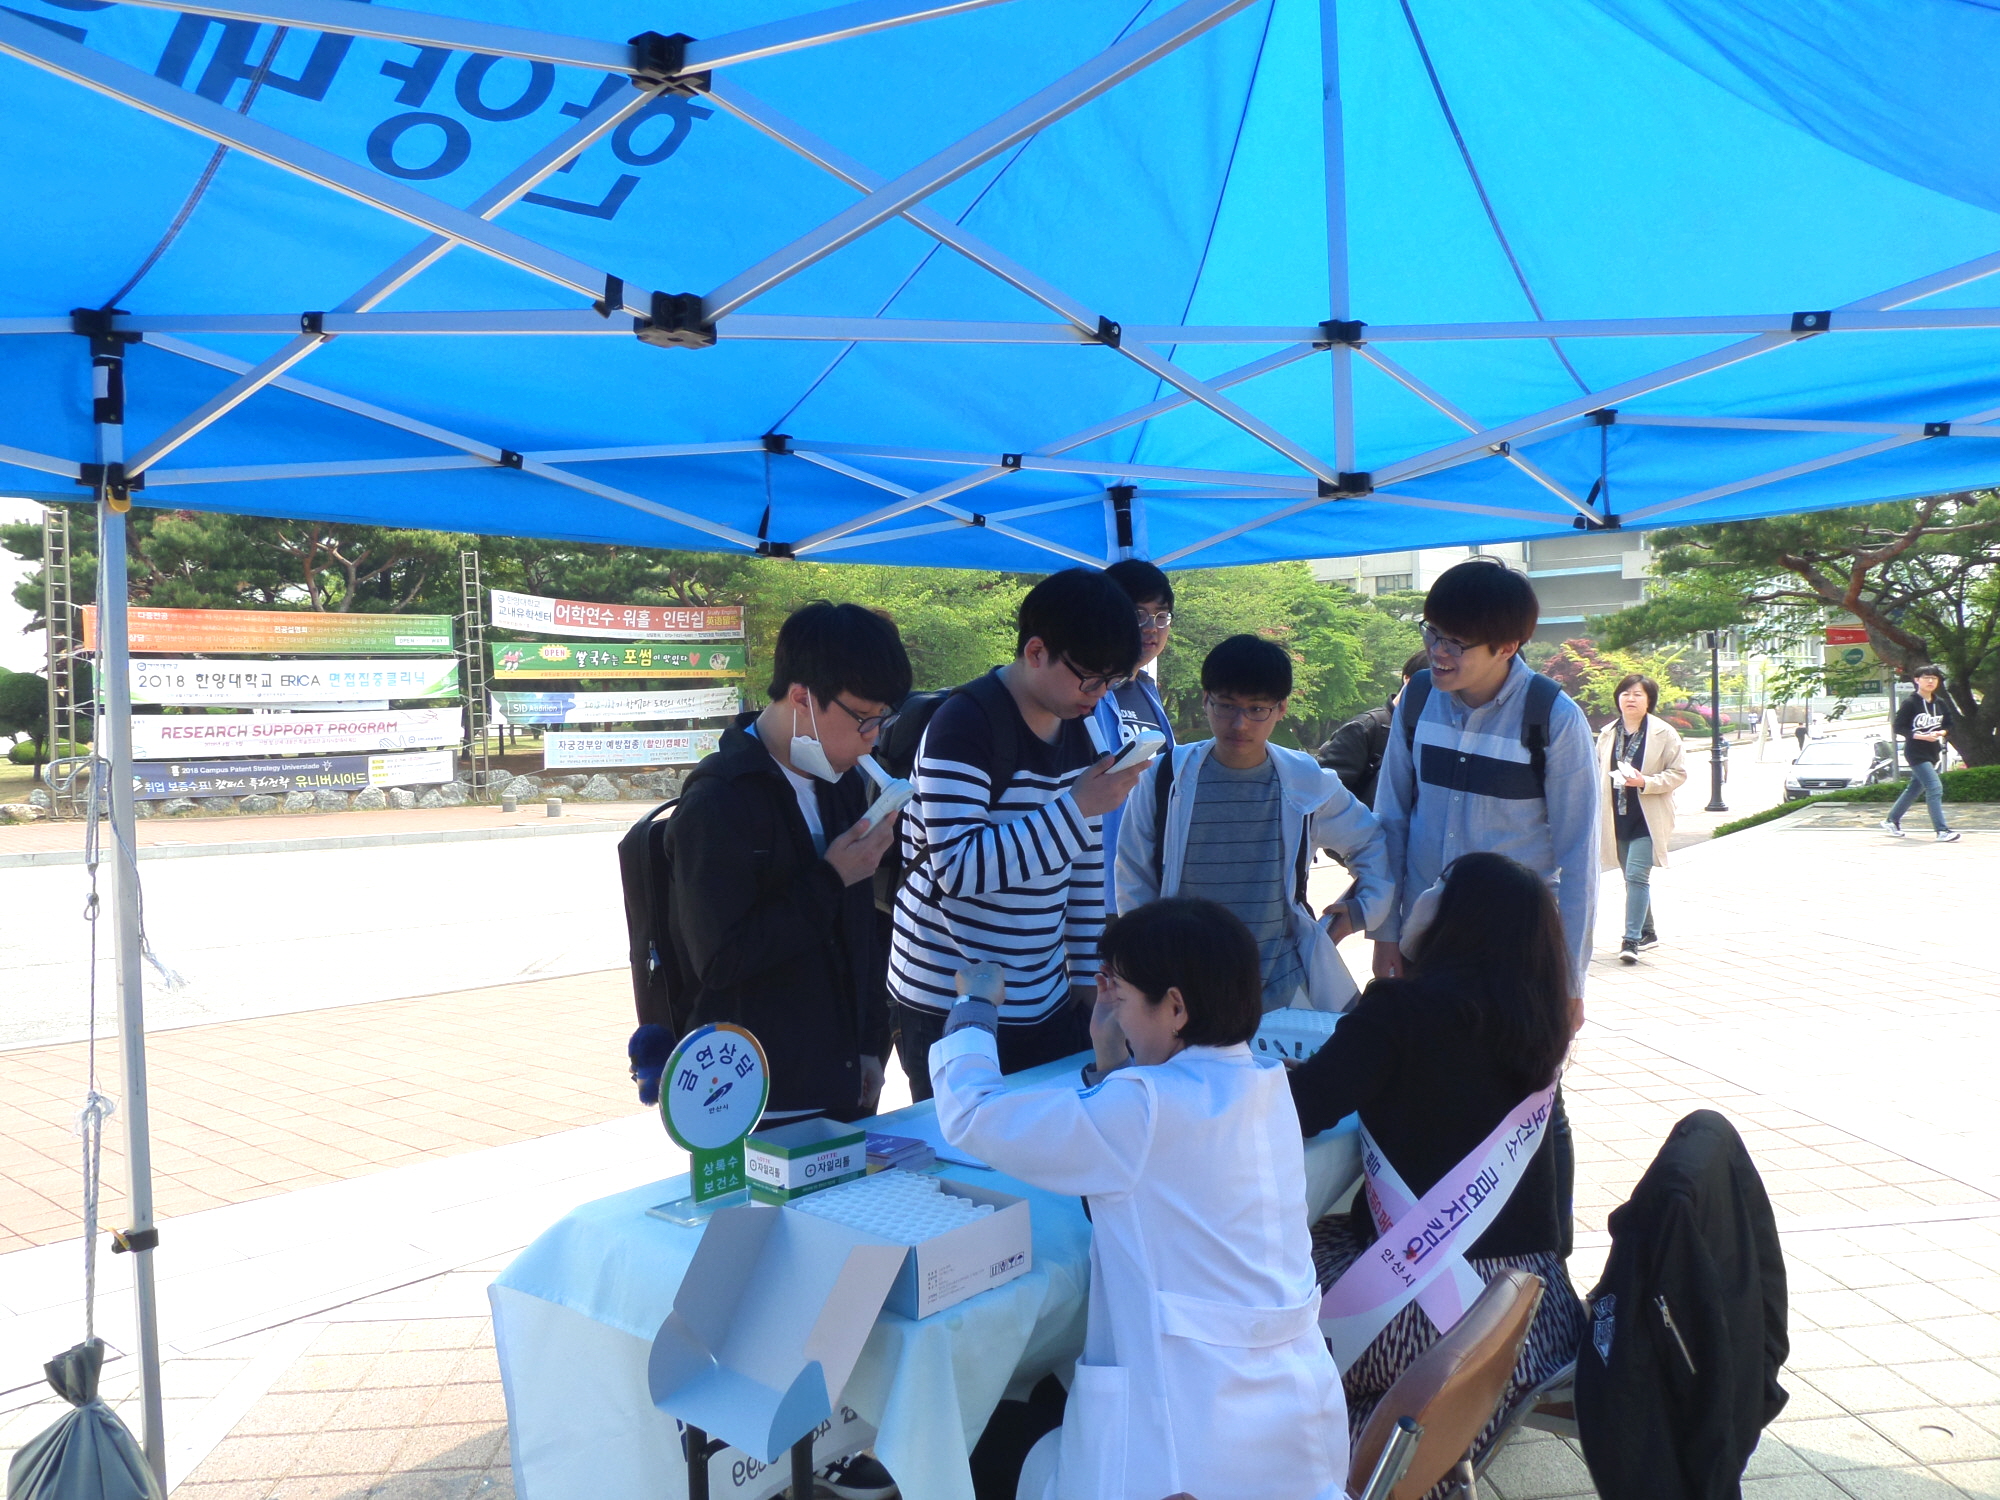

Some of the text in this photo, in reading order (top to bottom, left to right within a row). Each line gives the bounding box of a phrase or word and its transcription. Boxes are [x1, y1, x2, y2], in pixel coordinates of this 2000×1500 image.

[498, 605, 552, 622] 교내유학센터
[555, 604, 704, 629] 어학연수 워홀 인턴쉽
[543, 647, 566, 658] OPEN
[575, 650, 619, 668] 쌀국수는
[662, 653, 688, 666] 맛있다
[138, 675, 185, 688] 2018
[195, 673, 272, 689] 한양대학교
[281, 674, 321, 687] ERICA
[161, 720, 398, 740] RESEARCH SUPPORT PROGRAM
[558, 739, 602, 751] 자궁경부암
[606, 739, 640, 750] 예방접종
[200, 766, 228, 775] Campus
[230, 765, 252, 773] Patent
[253, 764, 281, 774] Strategy
[144, 781, 165, 793] 취업
[168, 780, 212, 792] 보증수표!
[295, 772, 368, 788] 유니버시아드
[677, 1042, 755, 1092] 금연상담
[708, 1104, 729, 1115] 안산시
[757, 1156, 771, 1165] LOTTE
[817, 1152, 838, 1162] LOTTE
[817, 1156, 851, 1173] 자일리톨
[703, 1155, 738, 1177] 상록수
[757, 1163, 780, 1179] 자일리톨
[704, 1176, 739, 1194] 보건소
[1406, 1166, 1500, 1265] 금연지킴이
[1381, 1248, 1417, 1288] 안산시
